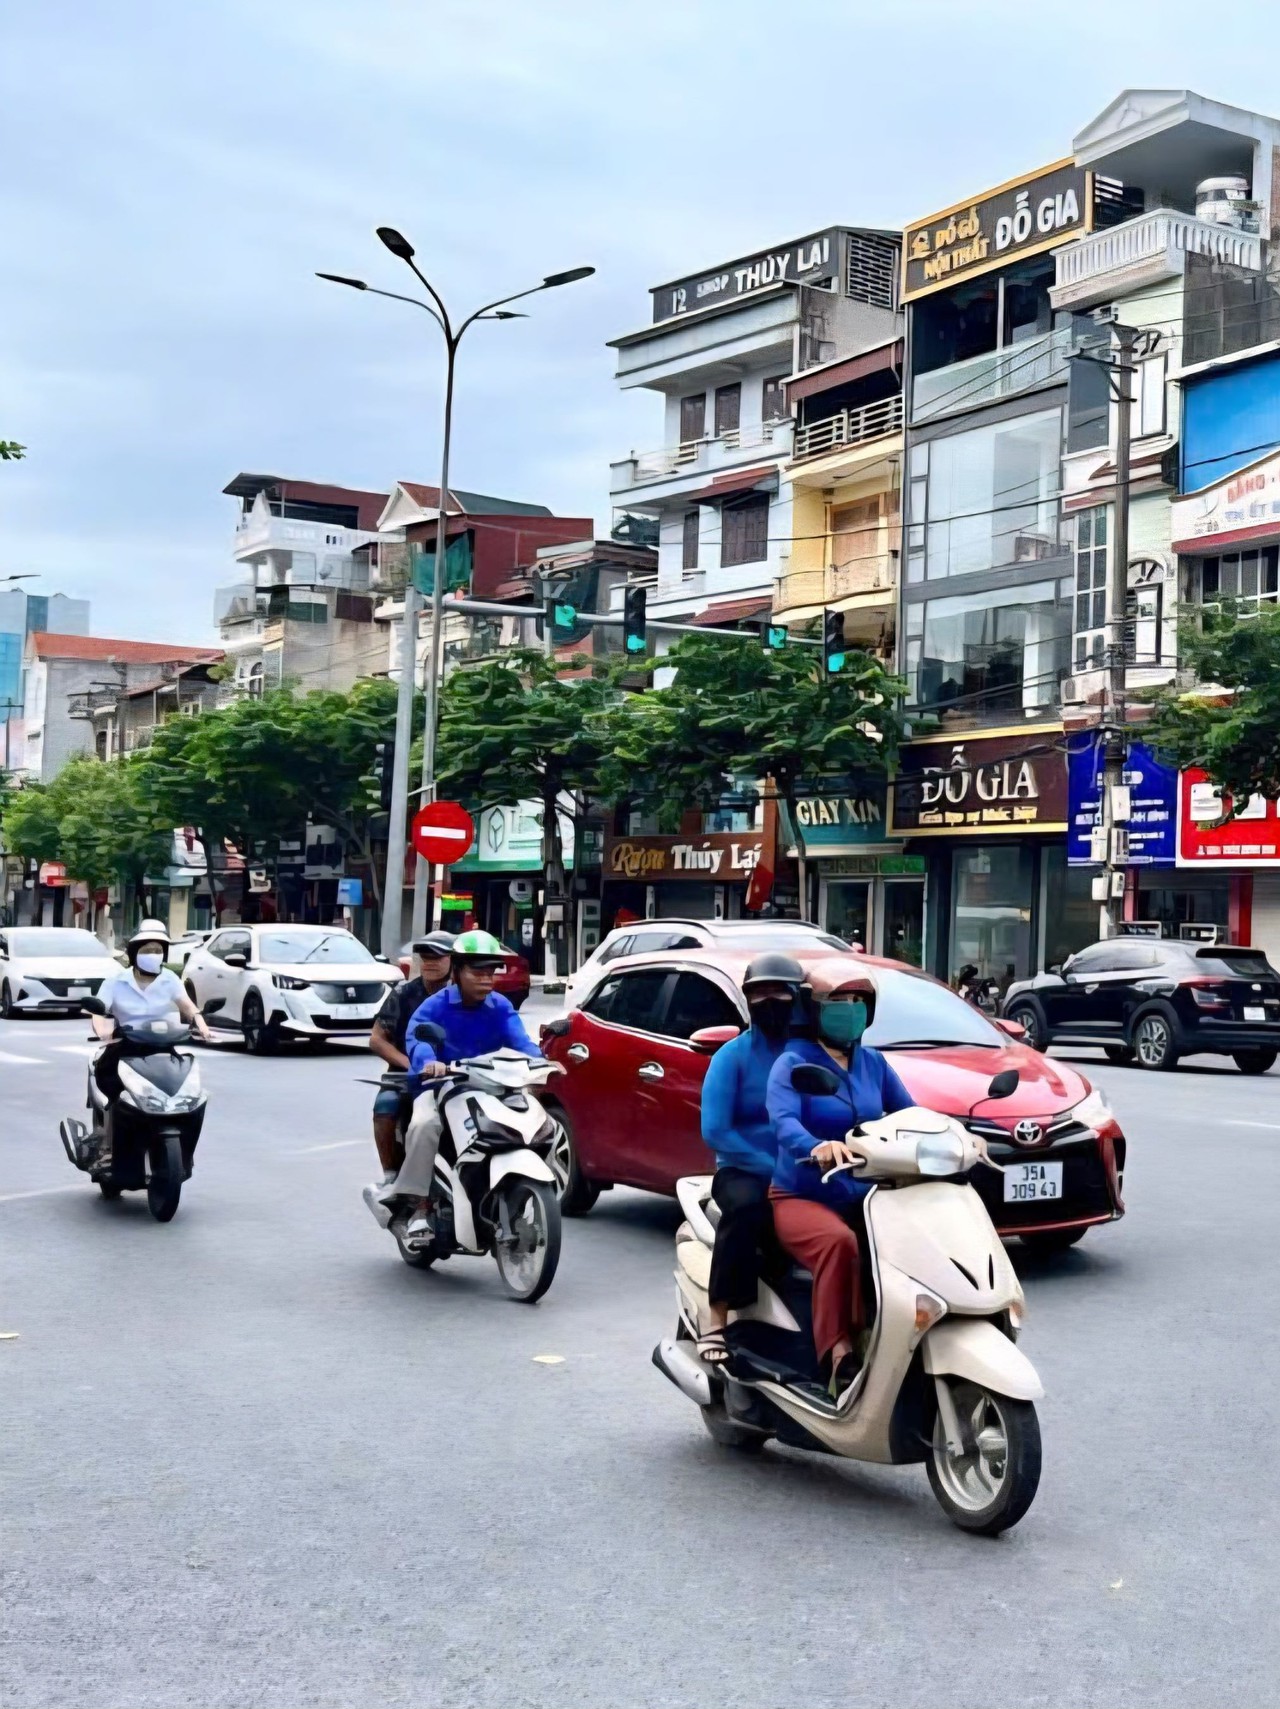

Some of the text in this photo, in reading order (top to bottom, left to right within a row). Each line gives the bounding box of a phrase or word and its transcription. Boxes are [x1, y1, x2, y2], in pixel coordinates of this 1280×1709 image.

[995, 188, 1079, 250] ĐỖ GIA
[976, 760, 1039, 800] GIA
[671, 840, 724, 874] Thúy
